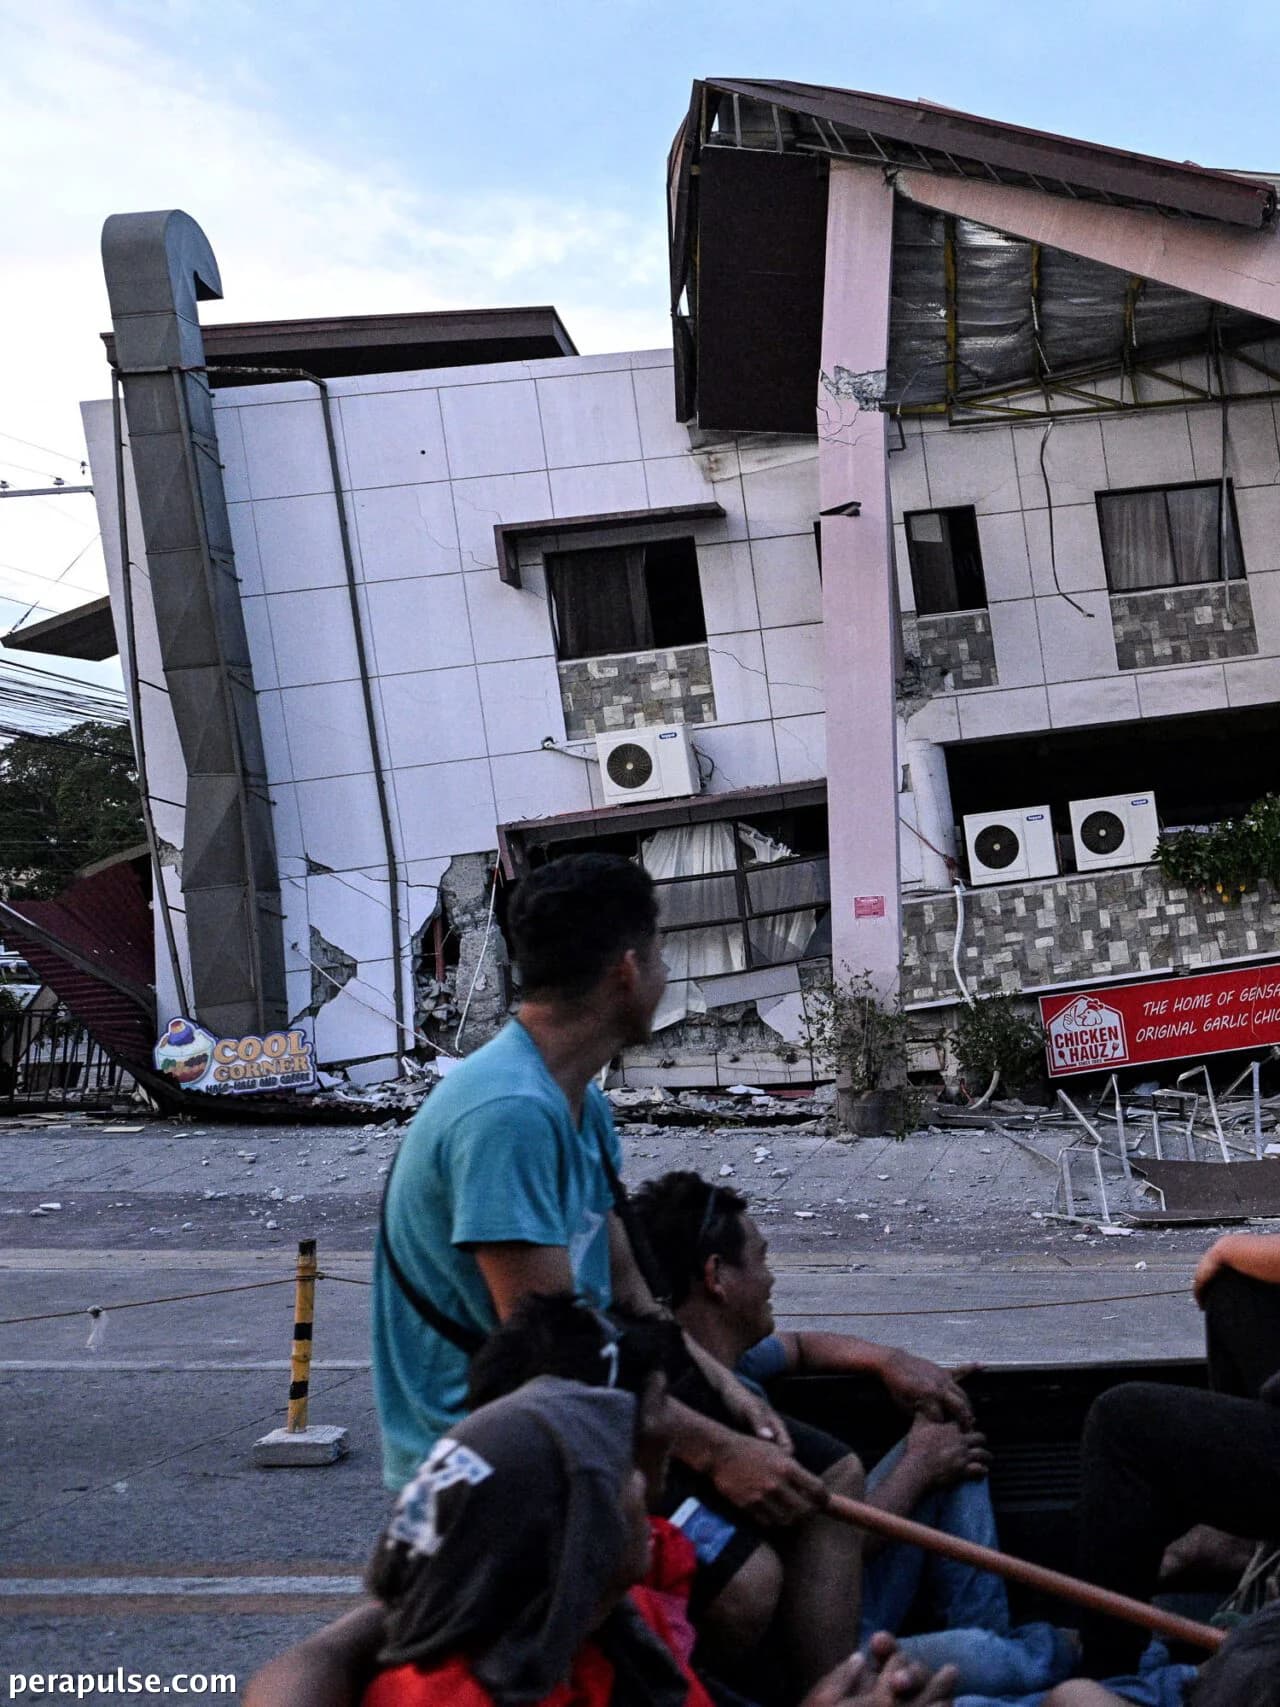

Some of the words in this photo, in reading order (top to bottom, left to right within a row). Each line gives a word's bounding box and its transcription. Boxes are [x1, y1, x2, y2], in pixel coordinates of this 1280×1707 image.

[1143, 999, 1169, 1016] THE
[1173, 993, 1213, 1012] HOME
[1217, 990, 1235, 1006] OF
[1054, 1025, 1119, 1049] CHICKEN
[1136, 1021, 1197, 1043] ORIGINAL
[1203, 1013, 1249, 1032] GARLIC
[213, 1031, 310, 1064] COOL
[1069, 1043, 1109, 1062] HAUZ
[213, 1055, 310, 1082] CORNER
